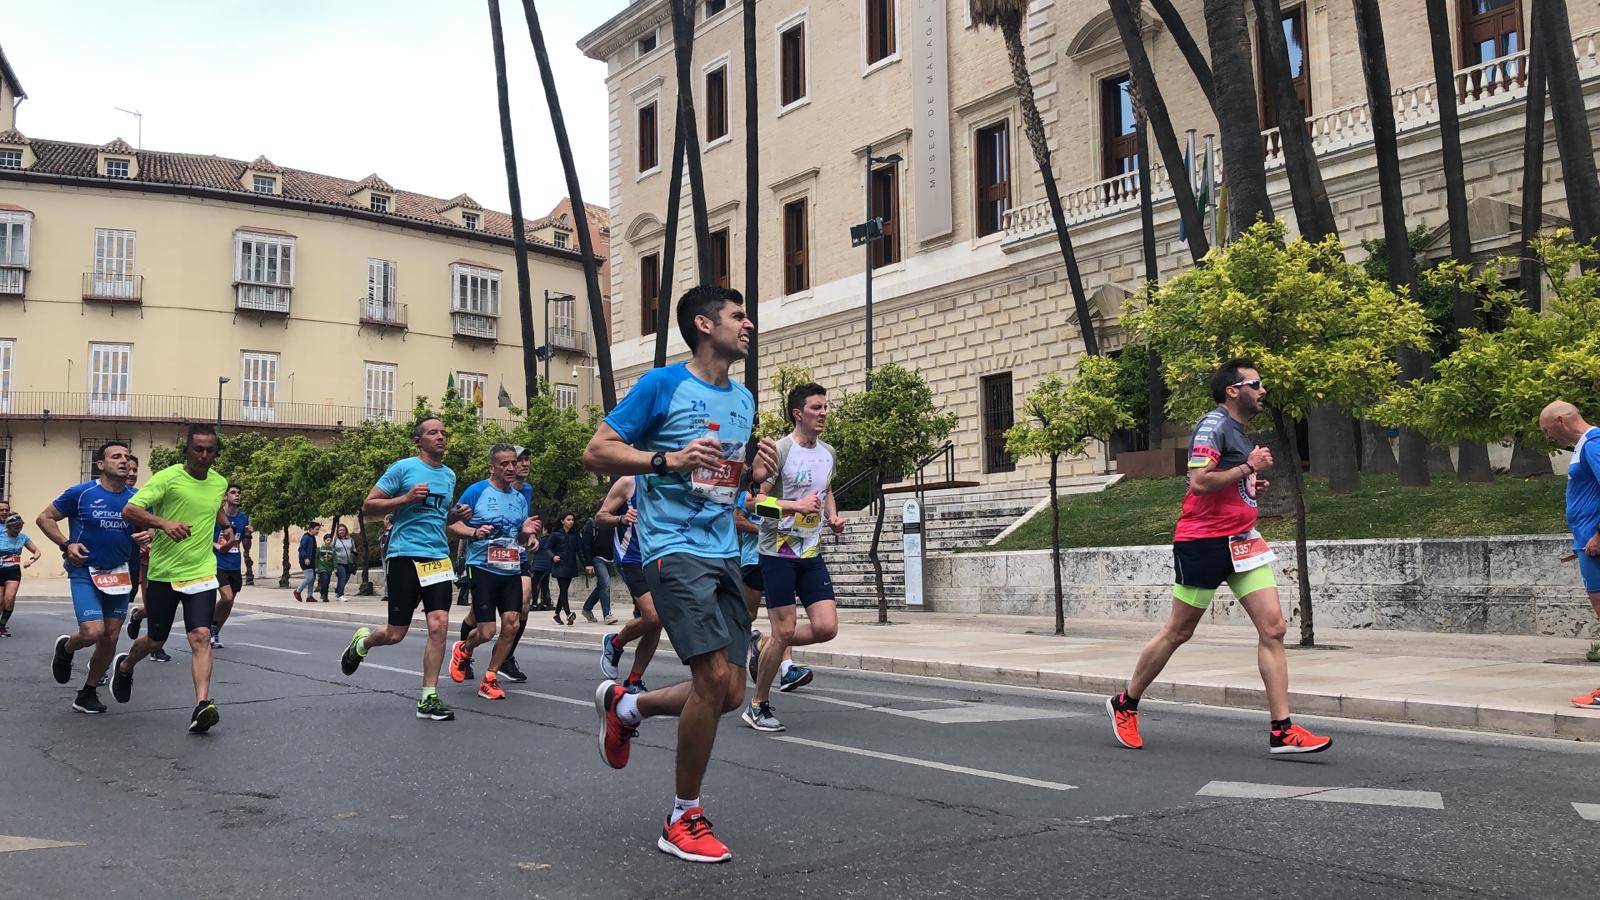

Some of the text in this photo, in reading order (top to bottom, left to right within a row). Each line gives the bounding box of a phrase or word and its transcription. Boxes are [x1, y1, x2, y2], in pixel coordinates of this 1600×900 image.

[927, 96, 935, 117] DE
[928, 129, 936, 189] MUSEO
[690, 400, 706, 411] 24
[491, 550, 511, 558] 4194
[421, 561, 442, 573] 7729
[97, 575, 119, 584] 4430
